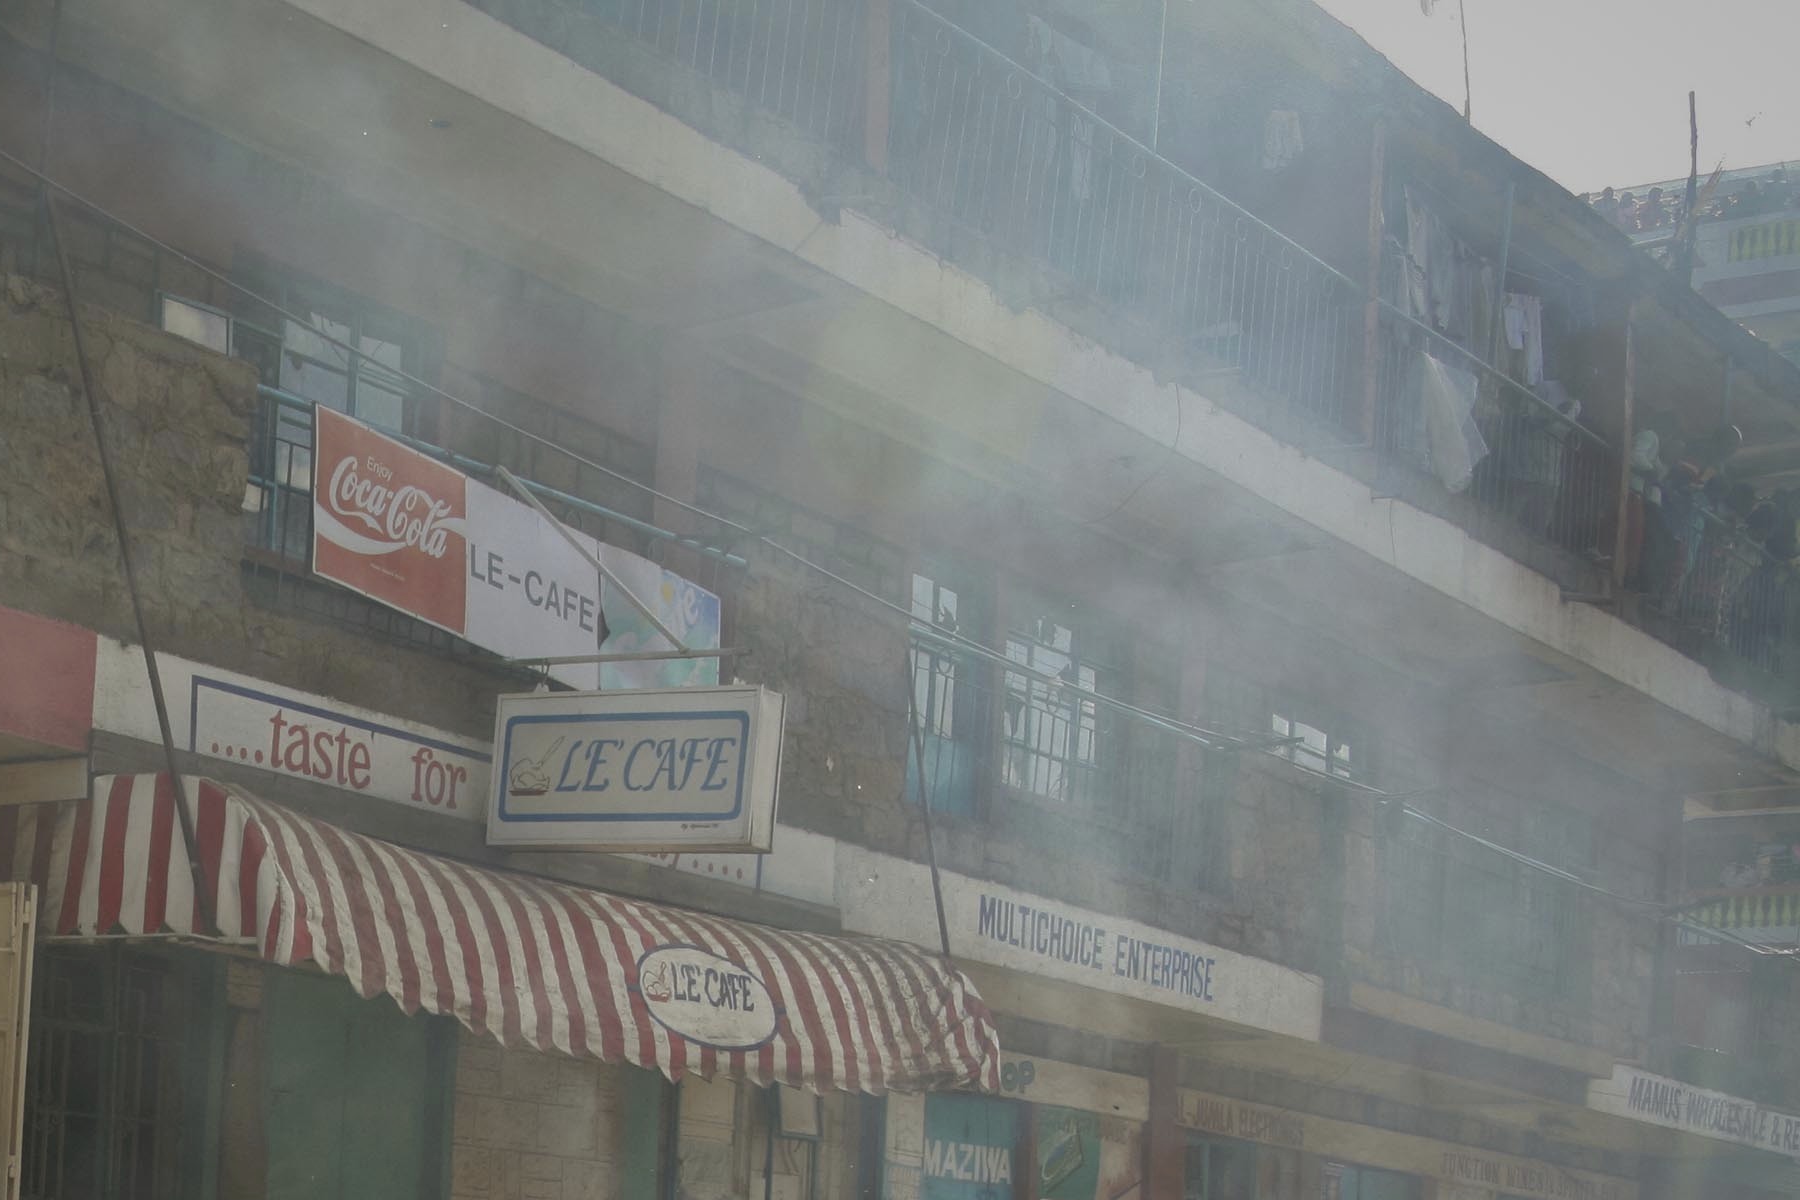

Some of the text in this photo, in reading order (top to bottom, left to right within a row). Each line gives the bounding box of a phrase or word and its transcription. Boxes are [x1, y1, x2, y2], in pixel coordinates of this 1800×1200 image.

[366, 455, 394, 483] Enjoy
[328, 455, 452, 559] Coca-Cola
[470, 543, 595, 633] LE-CAFE
[410, 746, 467, 810] for
[977, 893, 1216, 1002] MULTICHOICE ENTERPRISE
[704, 967, 755, 1012] CAFE
[924, 1138, 1012, 1185] MAZIWA
